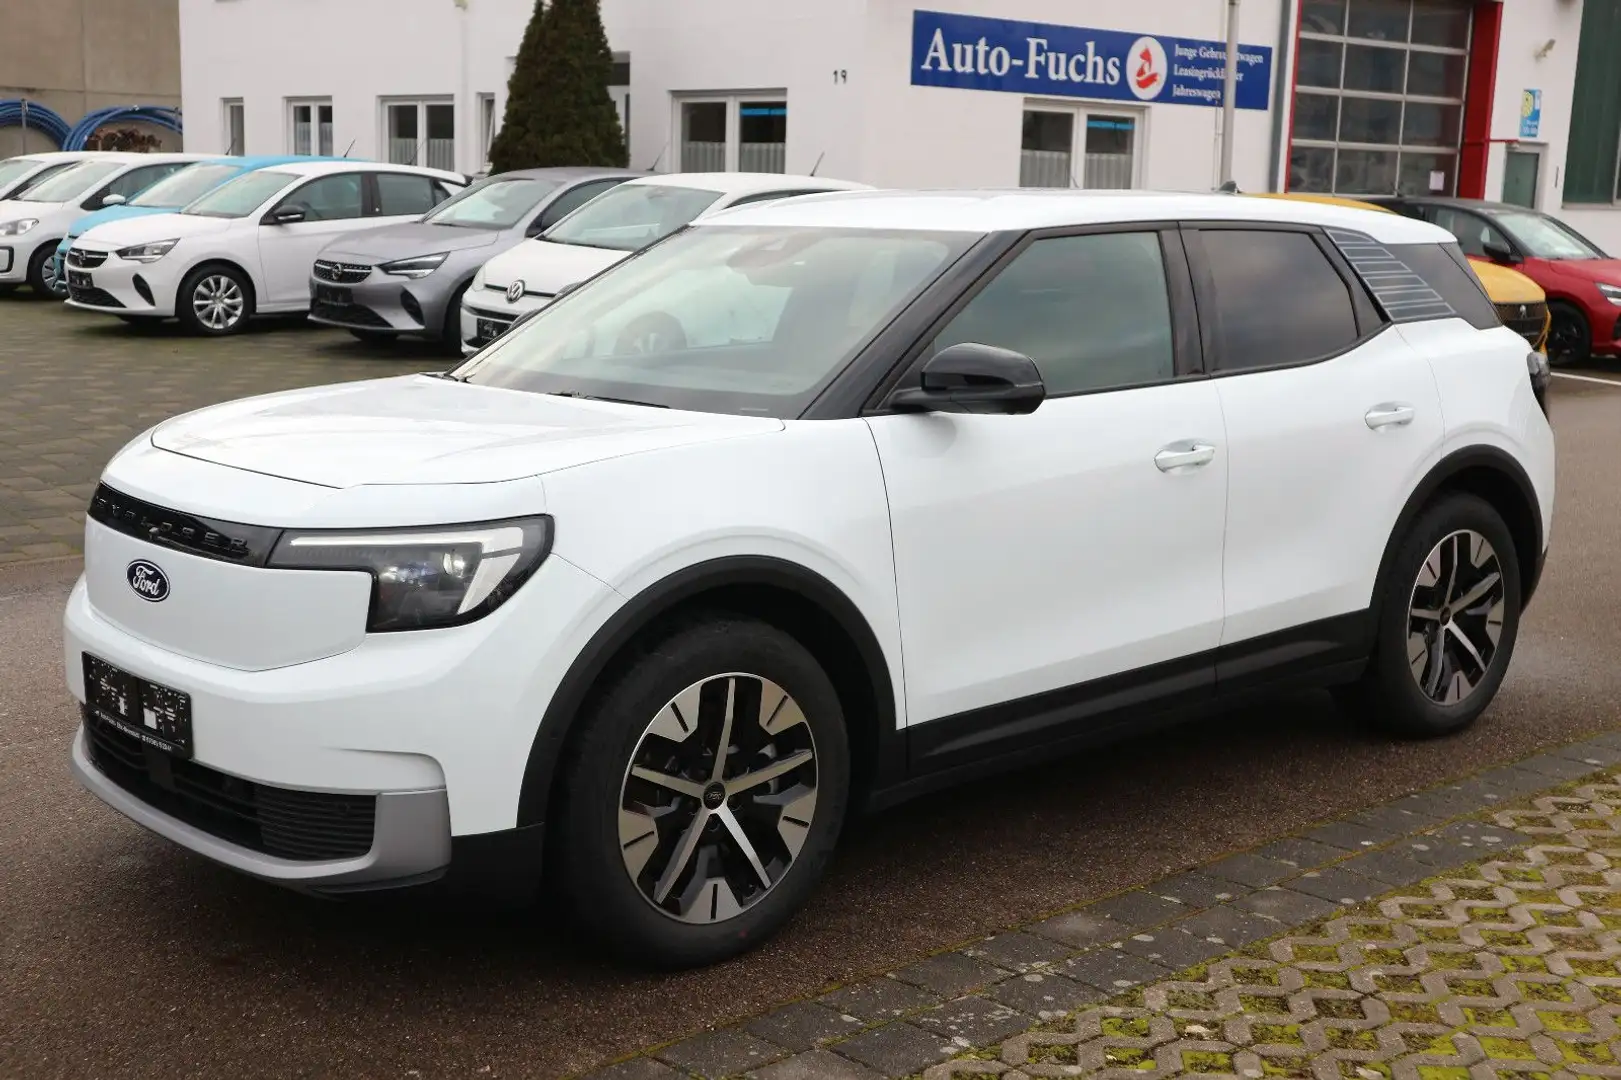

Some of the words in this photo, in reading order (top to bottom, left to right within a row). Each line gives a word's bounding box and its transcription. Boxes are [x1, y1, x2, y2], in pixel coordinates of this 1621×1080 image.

[920, 27, 1120, 86] Auto-Fuchs
[1175, 44, 1197, 60] Junge
[1199, 46, 1264, 66] Gebrautwagen
[833, 69, 848, 86] 19
[1172, 84, 1221, 102] Jahreswagen
[131, 563, 162, 598] Ford
